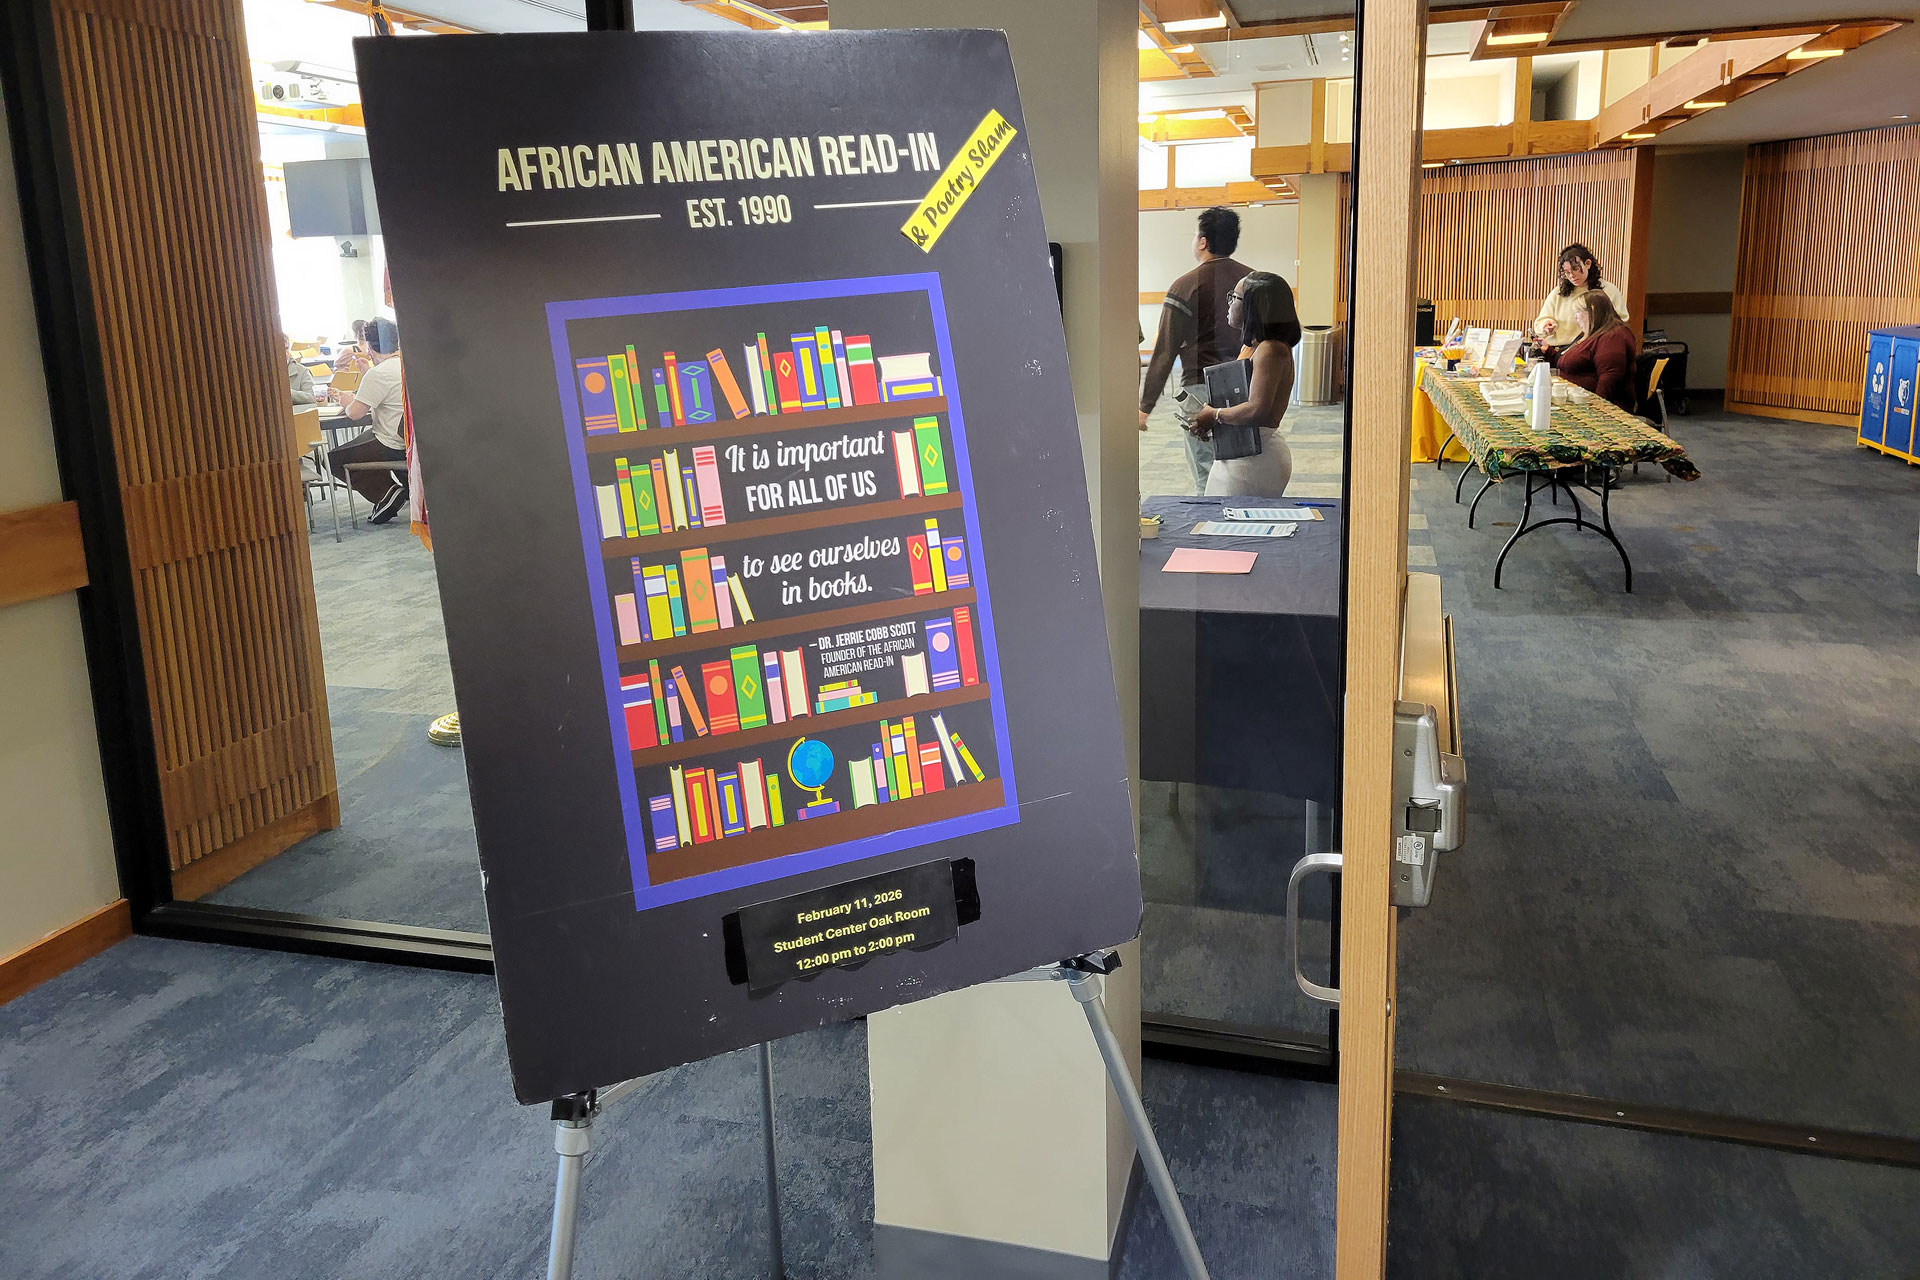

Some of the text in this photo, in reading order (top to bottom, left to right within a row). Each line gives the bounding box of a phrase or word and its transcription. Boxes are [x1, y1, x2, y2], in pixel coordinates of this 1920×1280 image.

[498, 132, 941, 191] AFRICAN AMERICAN READ-IN
[911, 120, 1012, 247] & Poetry Slam
[686, 194, 792, 228] EST. 1990
[725, 430, 885, 473] It is important
[745, 469, 877, 512] FOR ALL OF US
[742, 535, 900, 578] to see ourselves
[781, 571, 873, 605] in books.
[821, 637, 915, 665] FOUNDER OF THE AFRICAN
[835, 630, 865, 648] JERRIE
[865, 626, 888, 642] COBB
[890, 621, 916, 636] SCOTT
[823, 655, 894, 679] AMERICAN READ-IN
[797, 889, 903, 925] February 11, 2026
[773, 906, 930, 954] Student Center Oak Room
[796, 932, 915, 971] 12:00 pm to 2:00 pm
